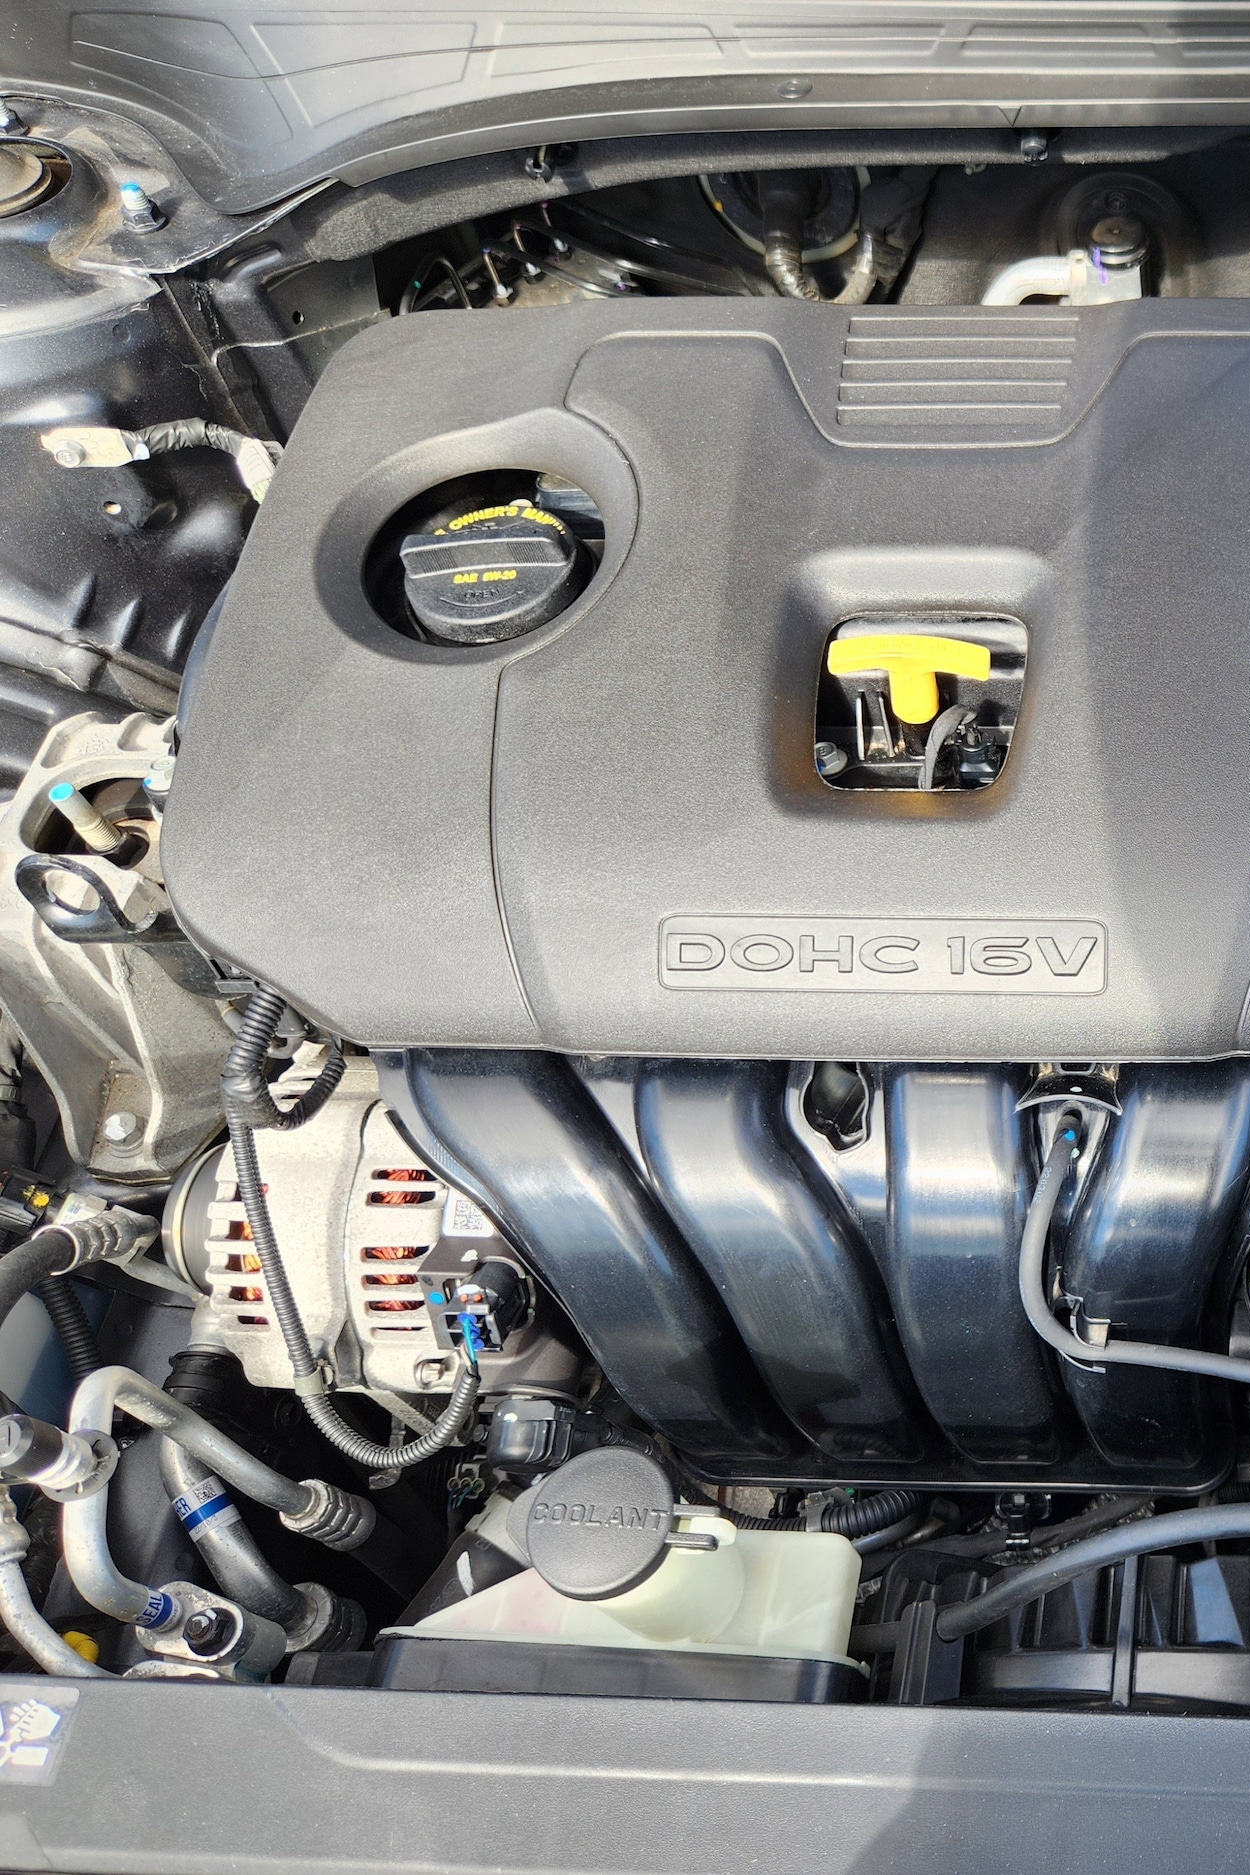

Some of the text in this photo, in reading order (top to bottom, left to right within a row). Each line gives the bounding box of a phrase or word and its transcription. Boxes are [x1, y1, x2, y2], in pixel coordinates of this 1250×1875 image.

[448, 506, 518, 530] OWNER'S
[453, 570, 517, 584] SAE 5W-20
[463, 587, 500, 599] OPEN
[666, 932, 1098, 977] DOHC 16V
[533, 1502, 668, 1531] COOLANT
[135, 1596, 162, 1624] SEAL
